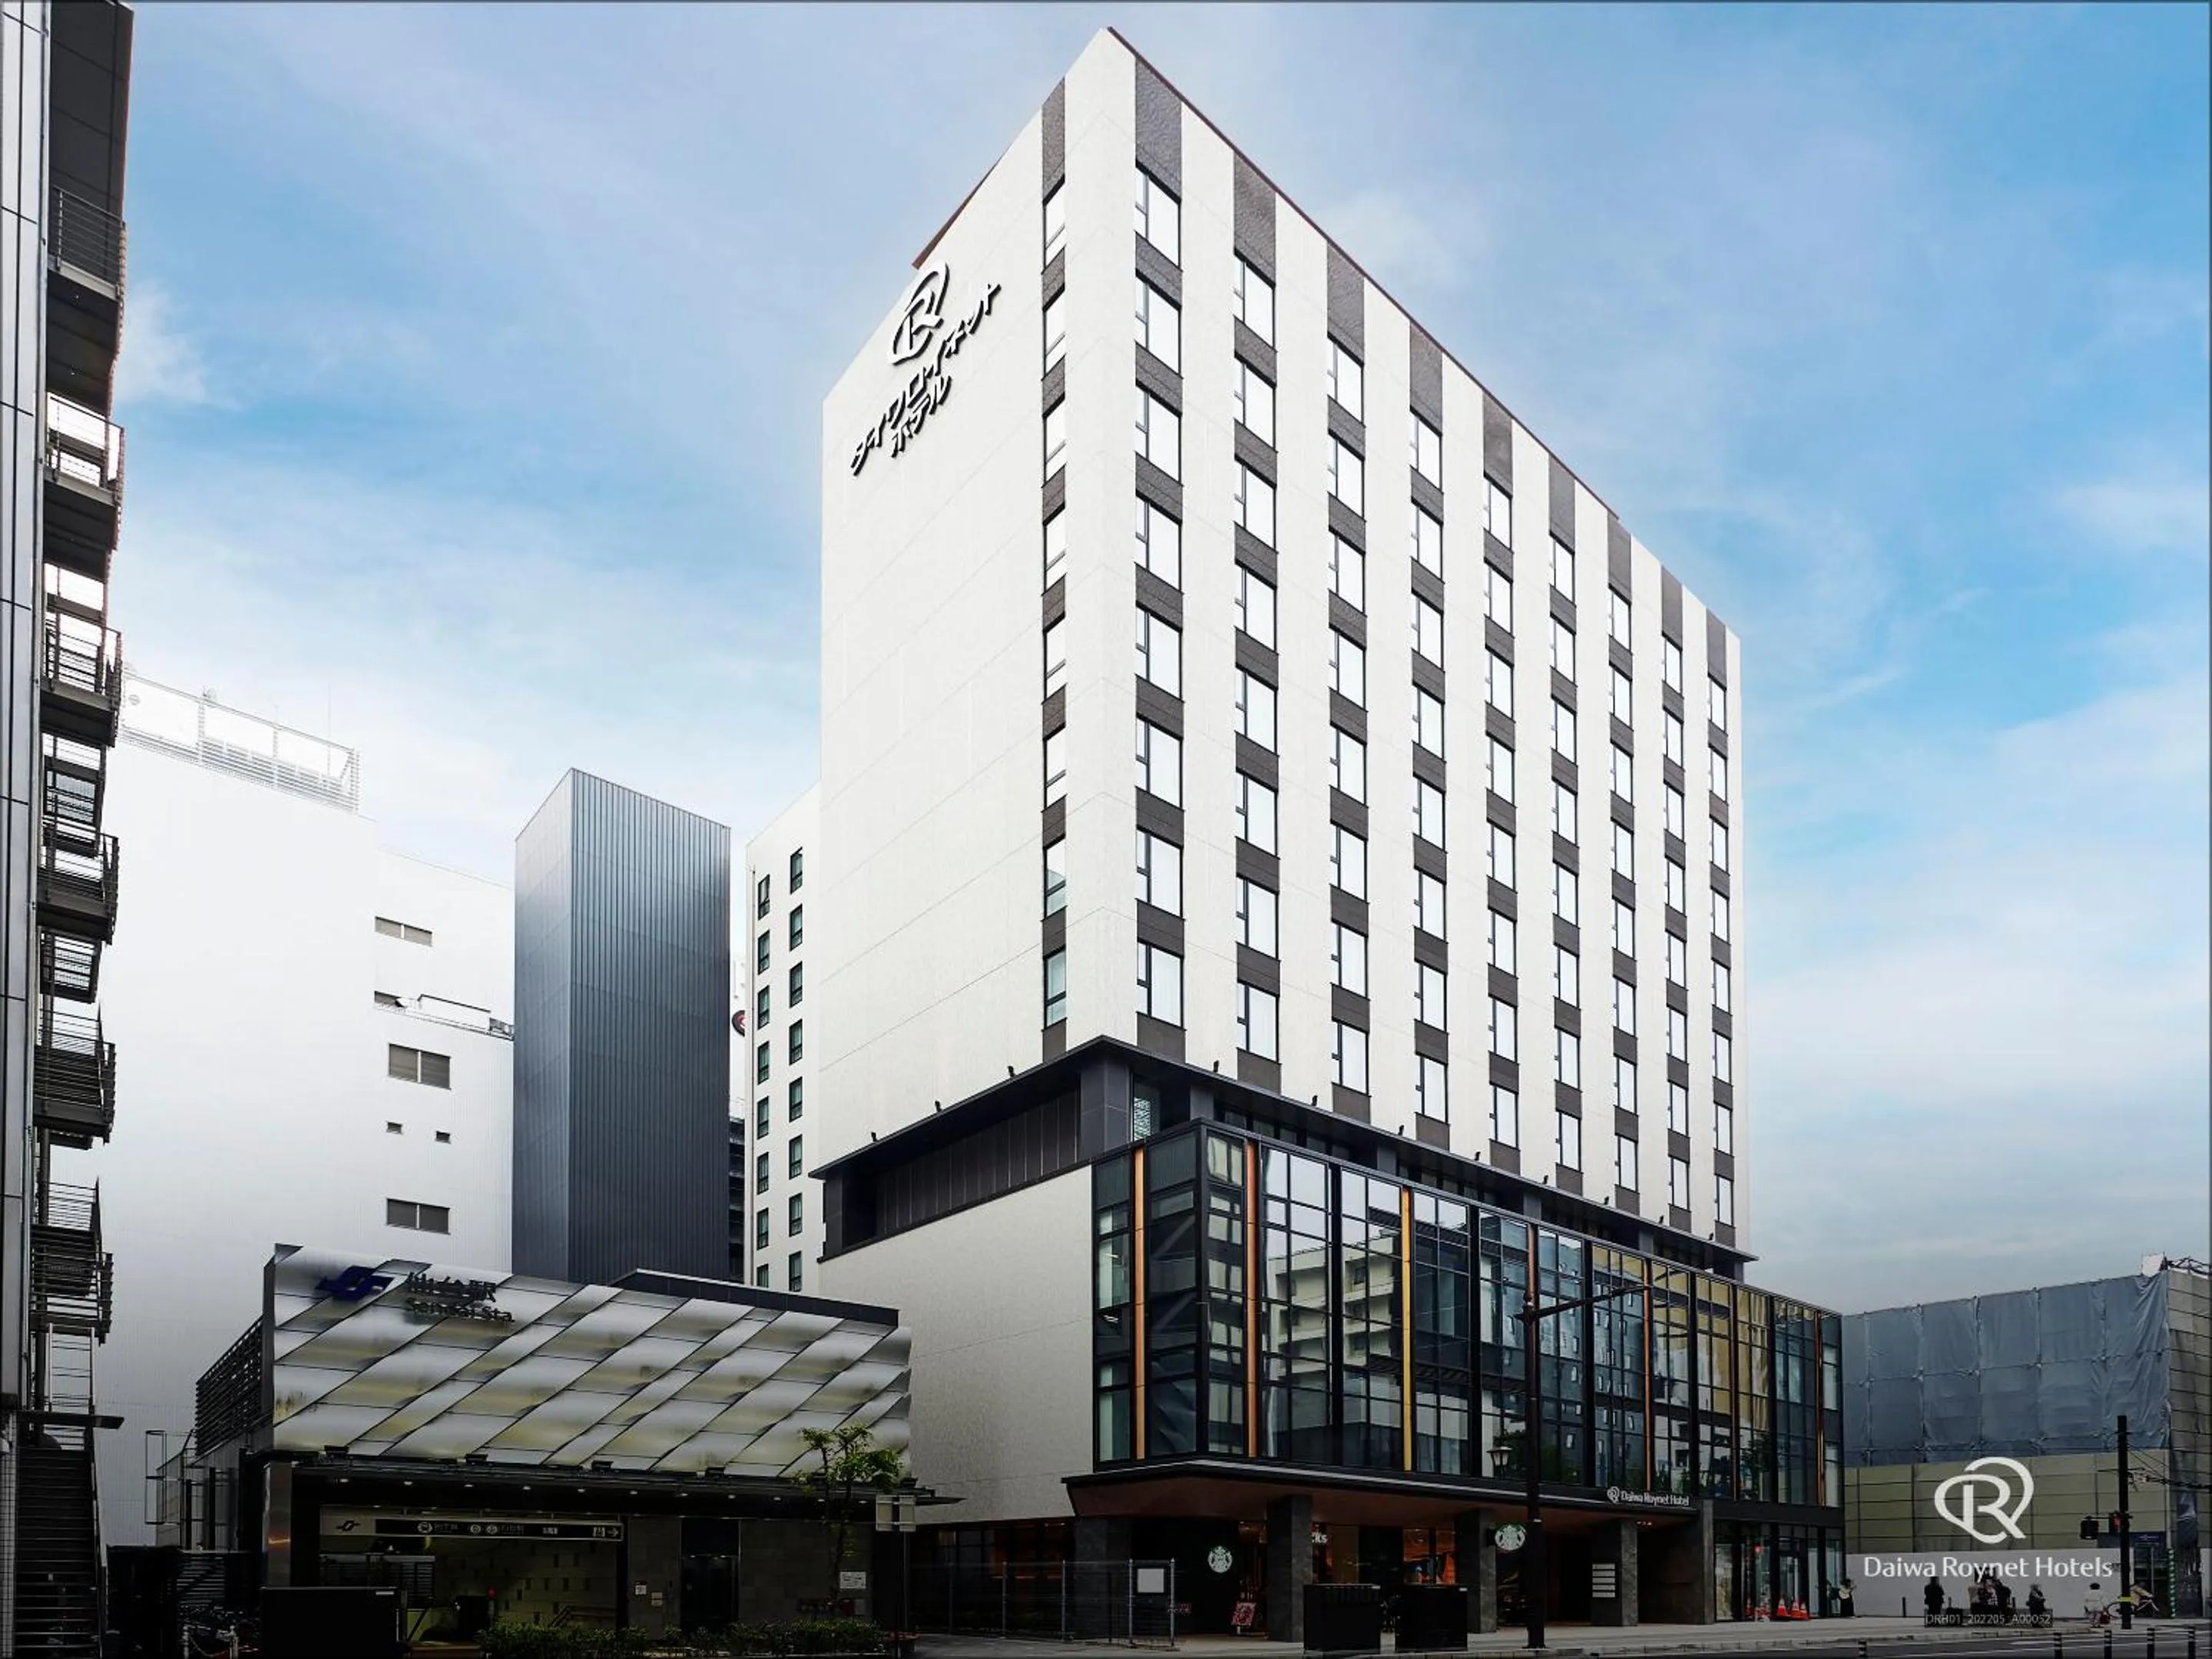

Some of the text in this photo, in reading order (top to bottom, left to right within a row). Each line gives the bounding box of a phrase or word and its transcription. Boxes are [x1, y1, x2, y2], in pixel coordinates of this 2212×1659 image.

[850, 283, 1002, 477] ダイワロイネット
[891, 375, 952, 459] ホテル
[1671, 1495, 1690, 1506] Hotel
